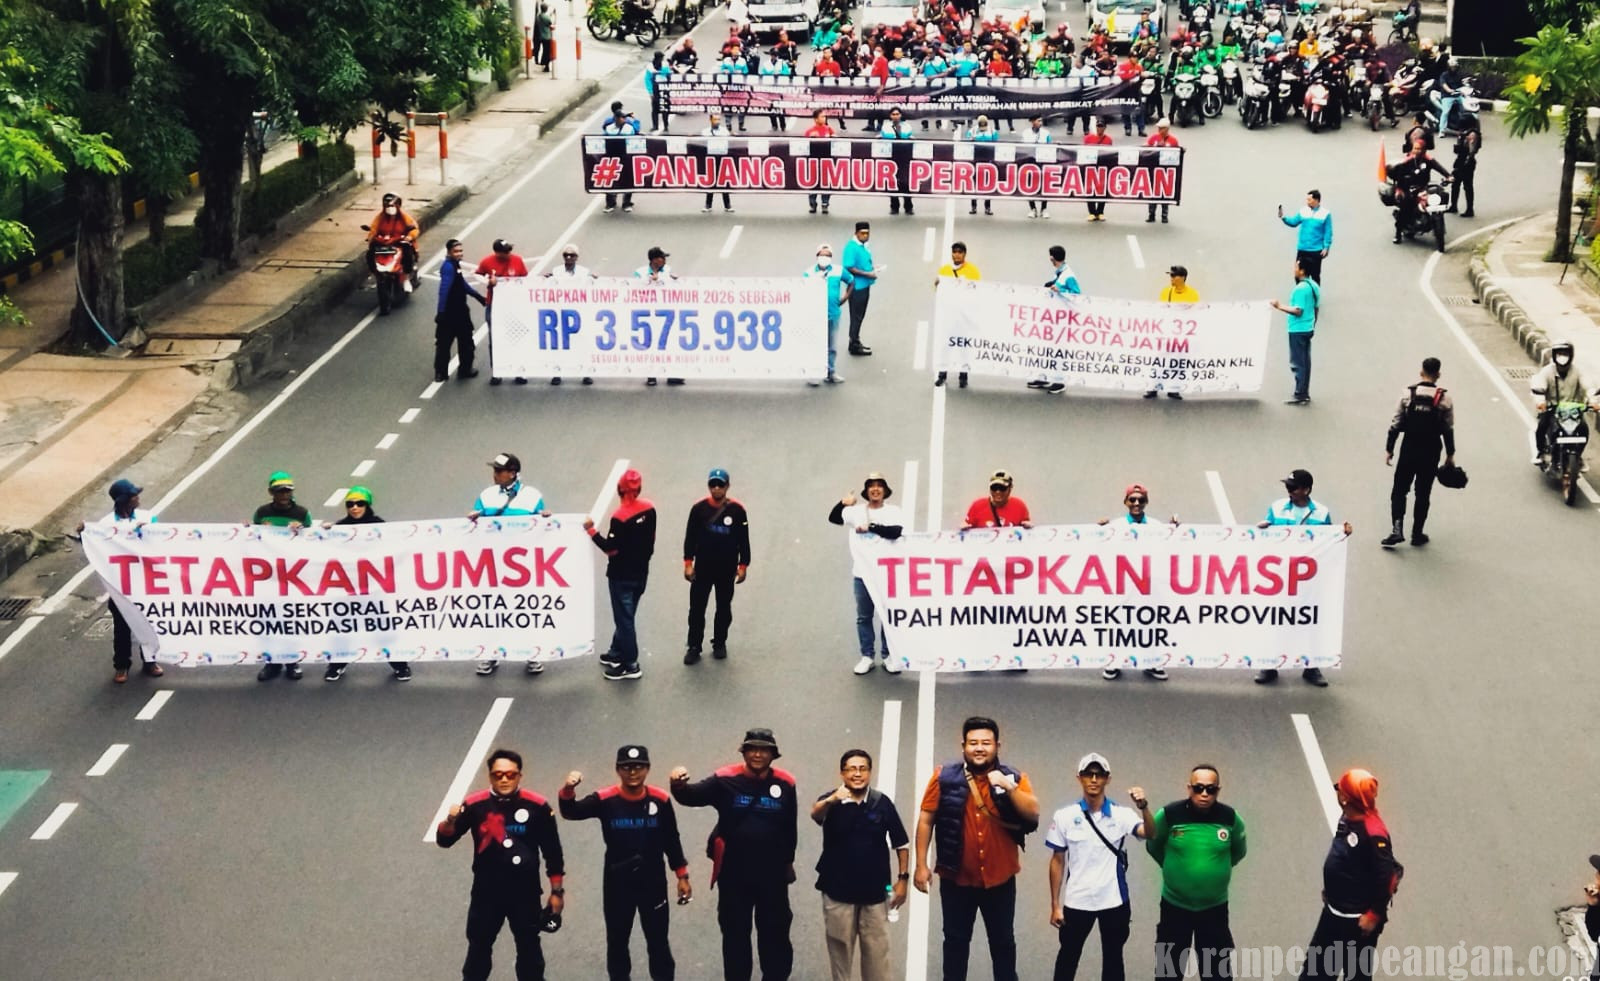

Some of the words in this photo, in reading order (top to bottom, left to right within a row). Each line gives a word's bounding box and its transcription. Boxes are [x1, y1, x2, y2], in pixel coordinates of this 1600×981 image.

[721, 84, 751, 92] TIMUR
[937, 95, 965, 103] JAWA
[966, 95, 999, 103] TIMUR.
[807, 101, 847, 109] DENGAN
[849, 102, 916, 110] REKOMENDASI
[954, 101, 1018, 110] PENGUPAHAN
[1018, 101, 1051, 110] UNSUR
[1052, 100, 1093, 109] SERIKAT
[632, 155, 785, 188] PANJANG
[796, 157, 899, 190] UMUR
[909, 160, 1177, 199] PERDJOEANGAN
[528, 288, 588, 303] TETAPKAN
[592, 288, 619, 303] UMP
[624, 289, 658, 304] JAWA
[661, 290, 700, 304] TIMUR
[703, 290, 735, 304] 2026
[739, 290, 791, 304] SEBESAR
[538, 309, 582, 350] RP
[595, 309, 783, 351] 3.575.938
[1007, 303, 1111, 329] TETAPKAN
[1119, 316, 1163, 335] UMK
[1172, 319, 1198, 336] 32
[1012, 323, 1123, 347] KAB/KOTA
[1129, 335, 1190, 353] JATIM
[975, 350, 1014, 364] JAWA
[1017, 355, 1058, 371] TIMUR
[1062, 361, 1120, 376] SEBESAR
[1123, 365, 1146, 379] RP.
[1118, 354, 1166, 368] SESUAI
[1169, 358, 1226, 369] DENGAN
[1229, 356, 1255, 368] KHL
[108, 554, 396, 597] TETAPKAN
[413, 546, 571, 591] UMSK
[877, 554, 1152, 598] TETAPKAN
[1169, 554, 1318, 597] UMSP
[182, 602, 277, 618] MINIMUM
[282, 600, 389, 618] SEKTORAL
[396, 594, 508, 614] KAB/KOTA
[513, 594, 566, 611] 2026
[950, 605, 1068, 626] MINIMUM
[1075, 604, 1191, 626] SEKTORA
[1198, 604, 1319, 626] PROVINSI
[209, 616, 359, 636] REKOMENDASI
[364, 612, 556, 633] BUPATI/WALIKOTA
[1013, 628, 1087, 648] JAWA
[1094, 628, 1178, 648] TIMUR.
